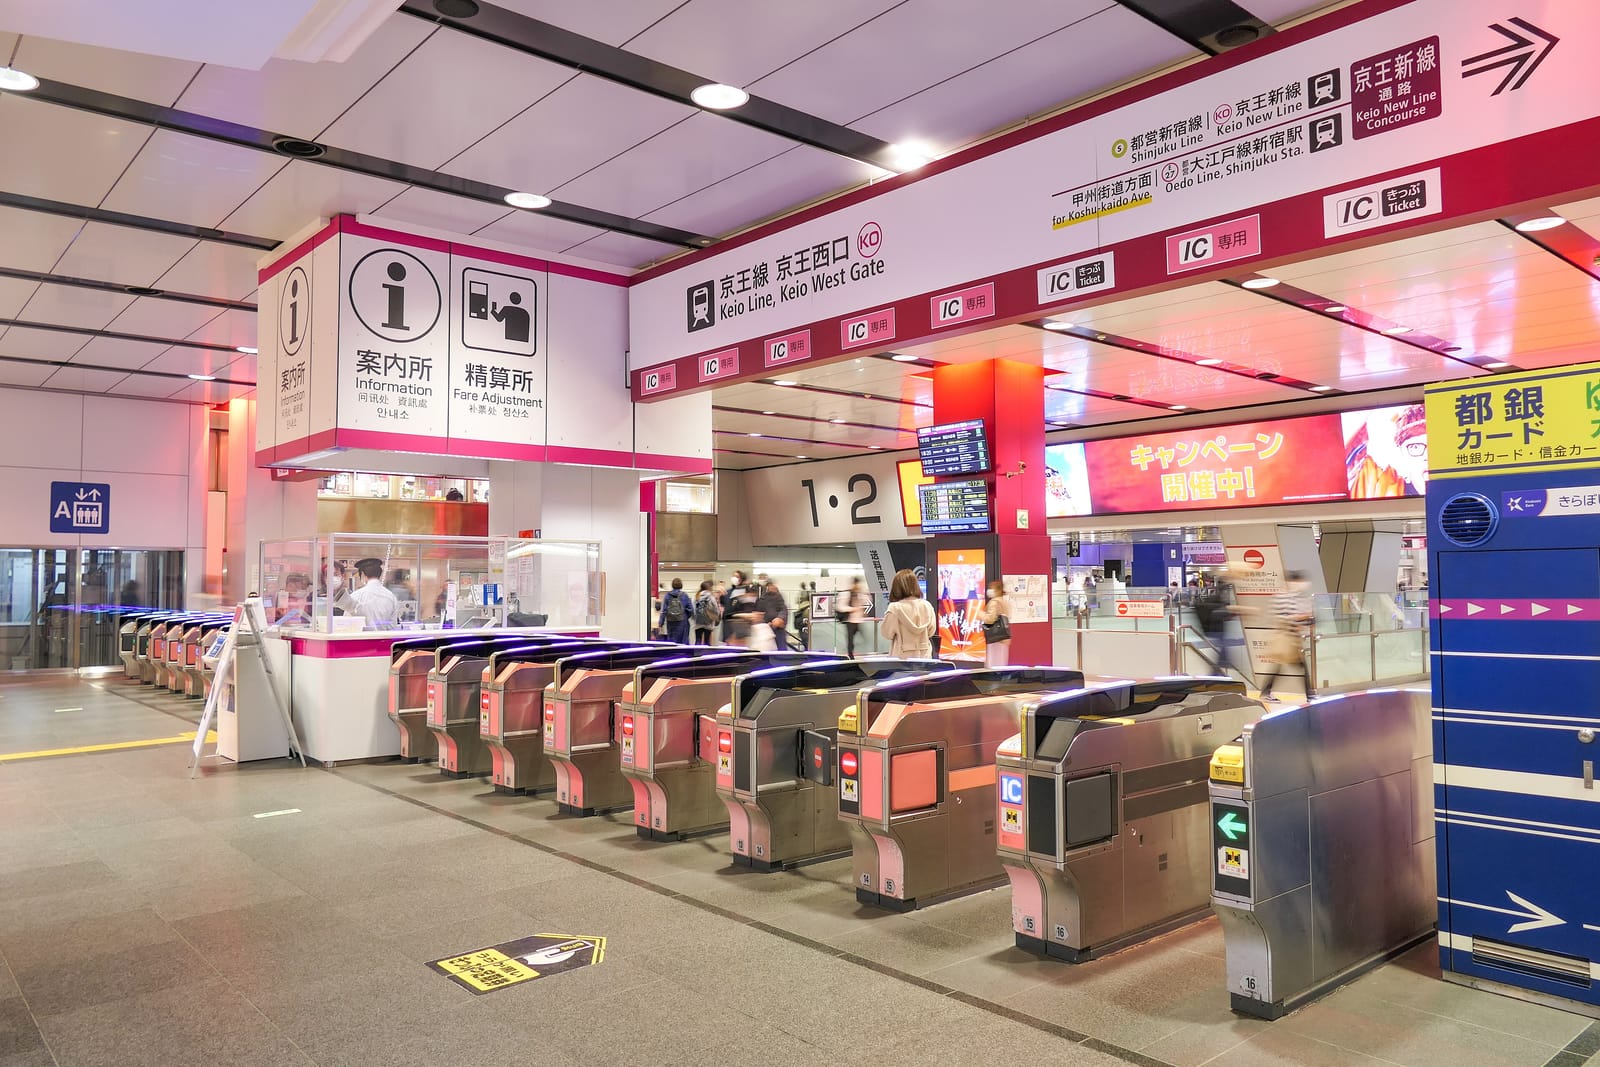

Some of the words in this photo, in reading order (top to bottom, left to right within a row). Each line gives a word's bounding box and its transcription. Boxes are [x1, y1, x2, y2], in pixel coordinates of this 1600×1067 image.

[1354, 44, 1436, 93] 京王新線
[1236, 82, 1302, 117] 京王新線
[1378, 81, 1412, 102] 通路
[1217, 120, 1242, 136] Keio
[1246, 110, 1273, 127] New
[1277, 102, 1302, 118] Line
[1356, 108, 1380, 122] Keio
[1384, 99, 1409, 114] New
[1413, 91, 1436, 105] Line
[1366, 106, 1426, 130] Concourse
[1130, 115, 1202, 152] 都営新宿線
[1131, 142, 1177, 164] Shinjuku
[1181, 134, 1204, 148] Line
[1190, 126, 1303, 174] 大江戸線新宿駅
[1164, 170, 1175, 179] 27
[1166, 178, 1194, 193] Oedo
[1197, 169, 1224, 184] Line,
[1226, 152, 1278, 176] Shinjuku
[1280, 146, 1304, 160] Sta.
[1072, 171, 1152, 208] 甲州街道方面
[1386, 184, 1420, 201] きっぷ
[1052, 215, 1066, 226] for
[1068, 197, 1129, 221] Koshu-kaido
[1130, 191, 1153, 204] Ave.
[1343, 196, 1374, 224] IC
[1389, 198, 1420, 214] Ticket
[1184, 238, 1208, 262] IC
[1218, 231, 1247, 250] 専用
[720, 262, 769, 300] 京王線
[776, 236, 849, 282] 京王西口
[1078, 262, 1101, 276] きっぷ
[1079, 272, 1101, 286] Ticket
[720, 300, 744, 320] Keio
[748, 293, 776, 312] Line,
[780, 280, 808, 302] Keio
[812, 268, 846, 293] West
[850, 258, 884, 282] Gate
[1050, 272, 1070, 292] IC
[942, 299, 960, 318] IC
[966, 295, 986, 310] 専用
[850, 322, 866, 340] IC
[871, 320, 888, 332] 専用
[773, 342, 786, 359] IC
[281, 361, 306, 392] 案内所
[355, 348, 433, 382] 案内所
[464, 362, 533, 394] 精算所
[706, 360, 717, 374] IC
[355, 376, 433, 396] Information
[648, 374, 657, 388] IC
[454, 388, 478, 401] Fare
[482, 392, 543, 408] Adjustment
[1455, 385, 1544, 426] 都銀
[376, 408, 409, 420] 안내소
[503, 407, 529, 418] 정산소
[1457, 421, 1544, 450] カード
[1130, 431, 1284, 470] キャンペーン
[1160, 466, 1257, 502] 開催中!
[54, 501, 72, 519] A
[1002, 776, 1022, 802] IC
[1026, 918, 1034, 930] 15
[1056, 926, 1065, 938] 16
[1246, 977, 1256, 990] 16
